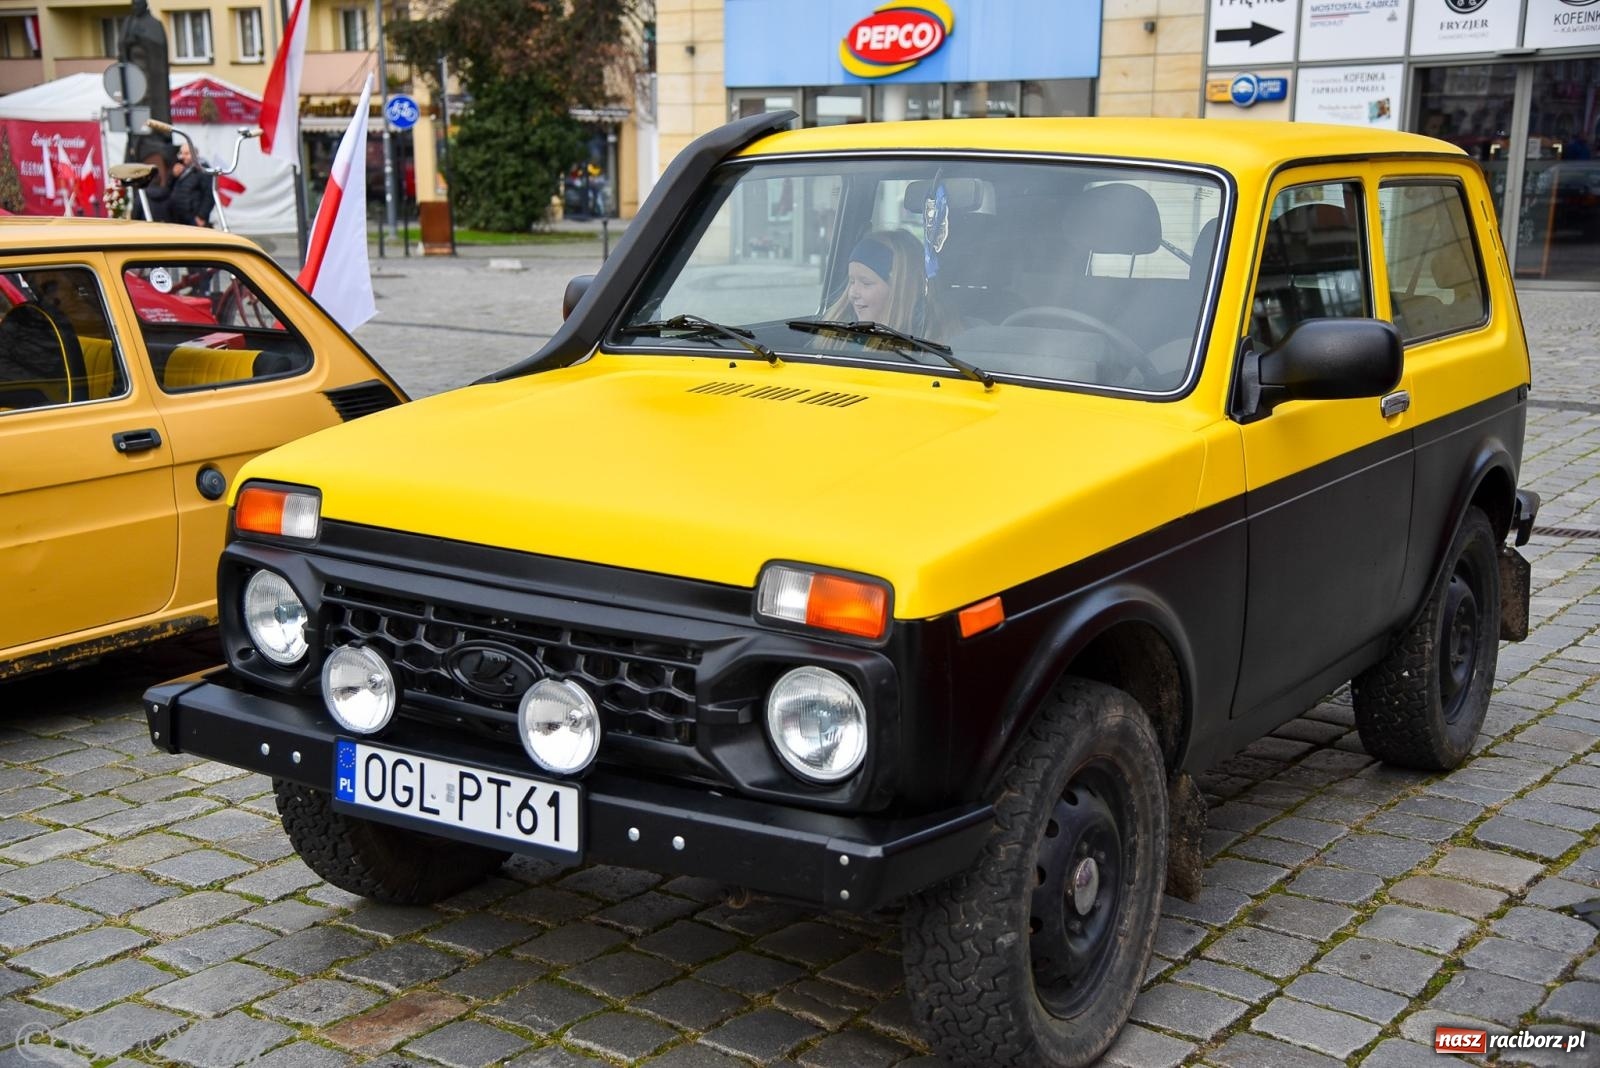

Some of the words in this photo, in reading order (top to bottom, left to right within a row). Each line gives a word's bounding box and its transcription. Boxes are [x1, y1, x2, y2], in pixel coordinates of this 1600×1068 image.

[1440, 19, 1489, 30] FRYZJER
[855, 22, 935, 51] PEPCO
[339, 777, 353, 793] PL
[364, 753, 440, 815] OGL
[459, 771, 560, 842] PT61
